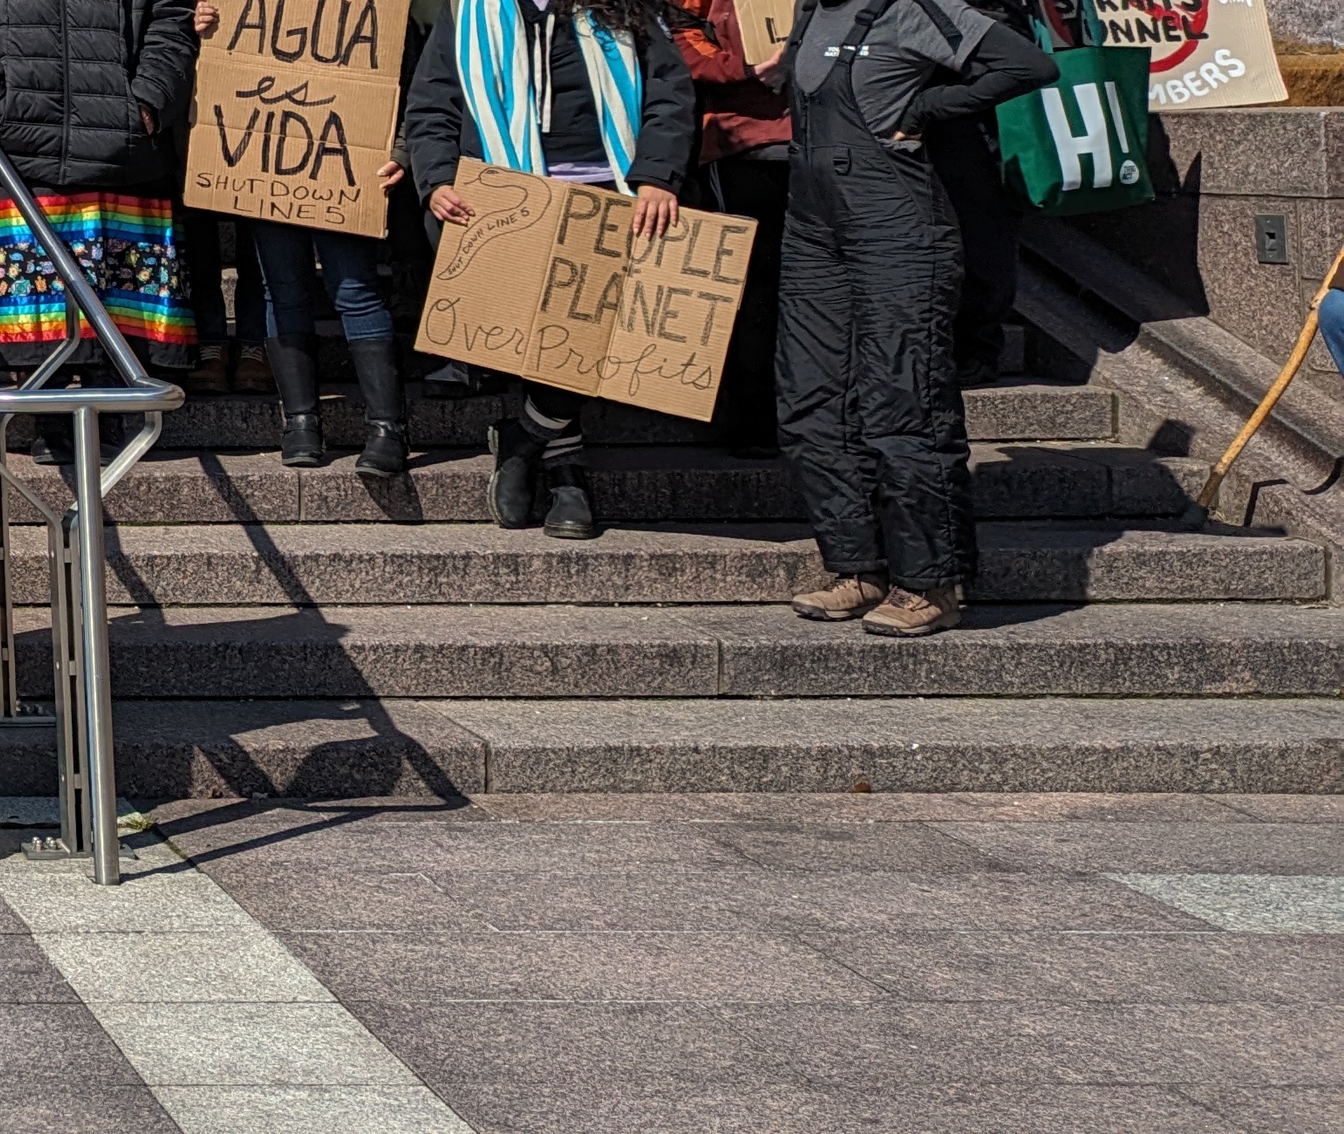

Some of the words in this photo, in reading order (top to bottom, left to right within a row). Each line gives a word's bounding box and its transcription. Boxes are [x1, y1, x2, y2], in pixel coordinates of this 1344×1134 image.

[235, 75, 337, 108] es
[214, 104, 356, 187] VIDA
[196, 172, 265, 194] SHUT
[270, 180, 360, 205] DOWN
[233, 195, 315, 220] LINE
[325, 206, 346, 225] 5
[448, 256, 464, 275] SHUT
[462, 228, 484, 255] DOWN
[486, 212, 518, 231] LINE
[520, 206, 530, 217] 5
[556, 188, 748, 286] PEOPLE
[540, 256, 733, 347] PLANET
[425, 296, 525, 355] Over
[537, 324, 715, 397] Profits
